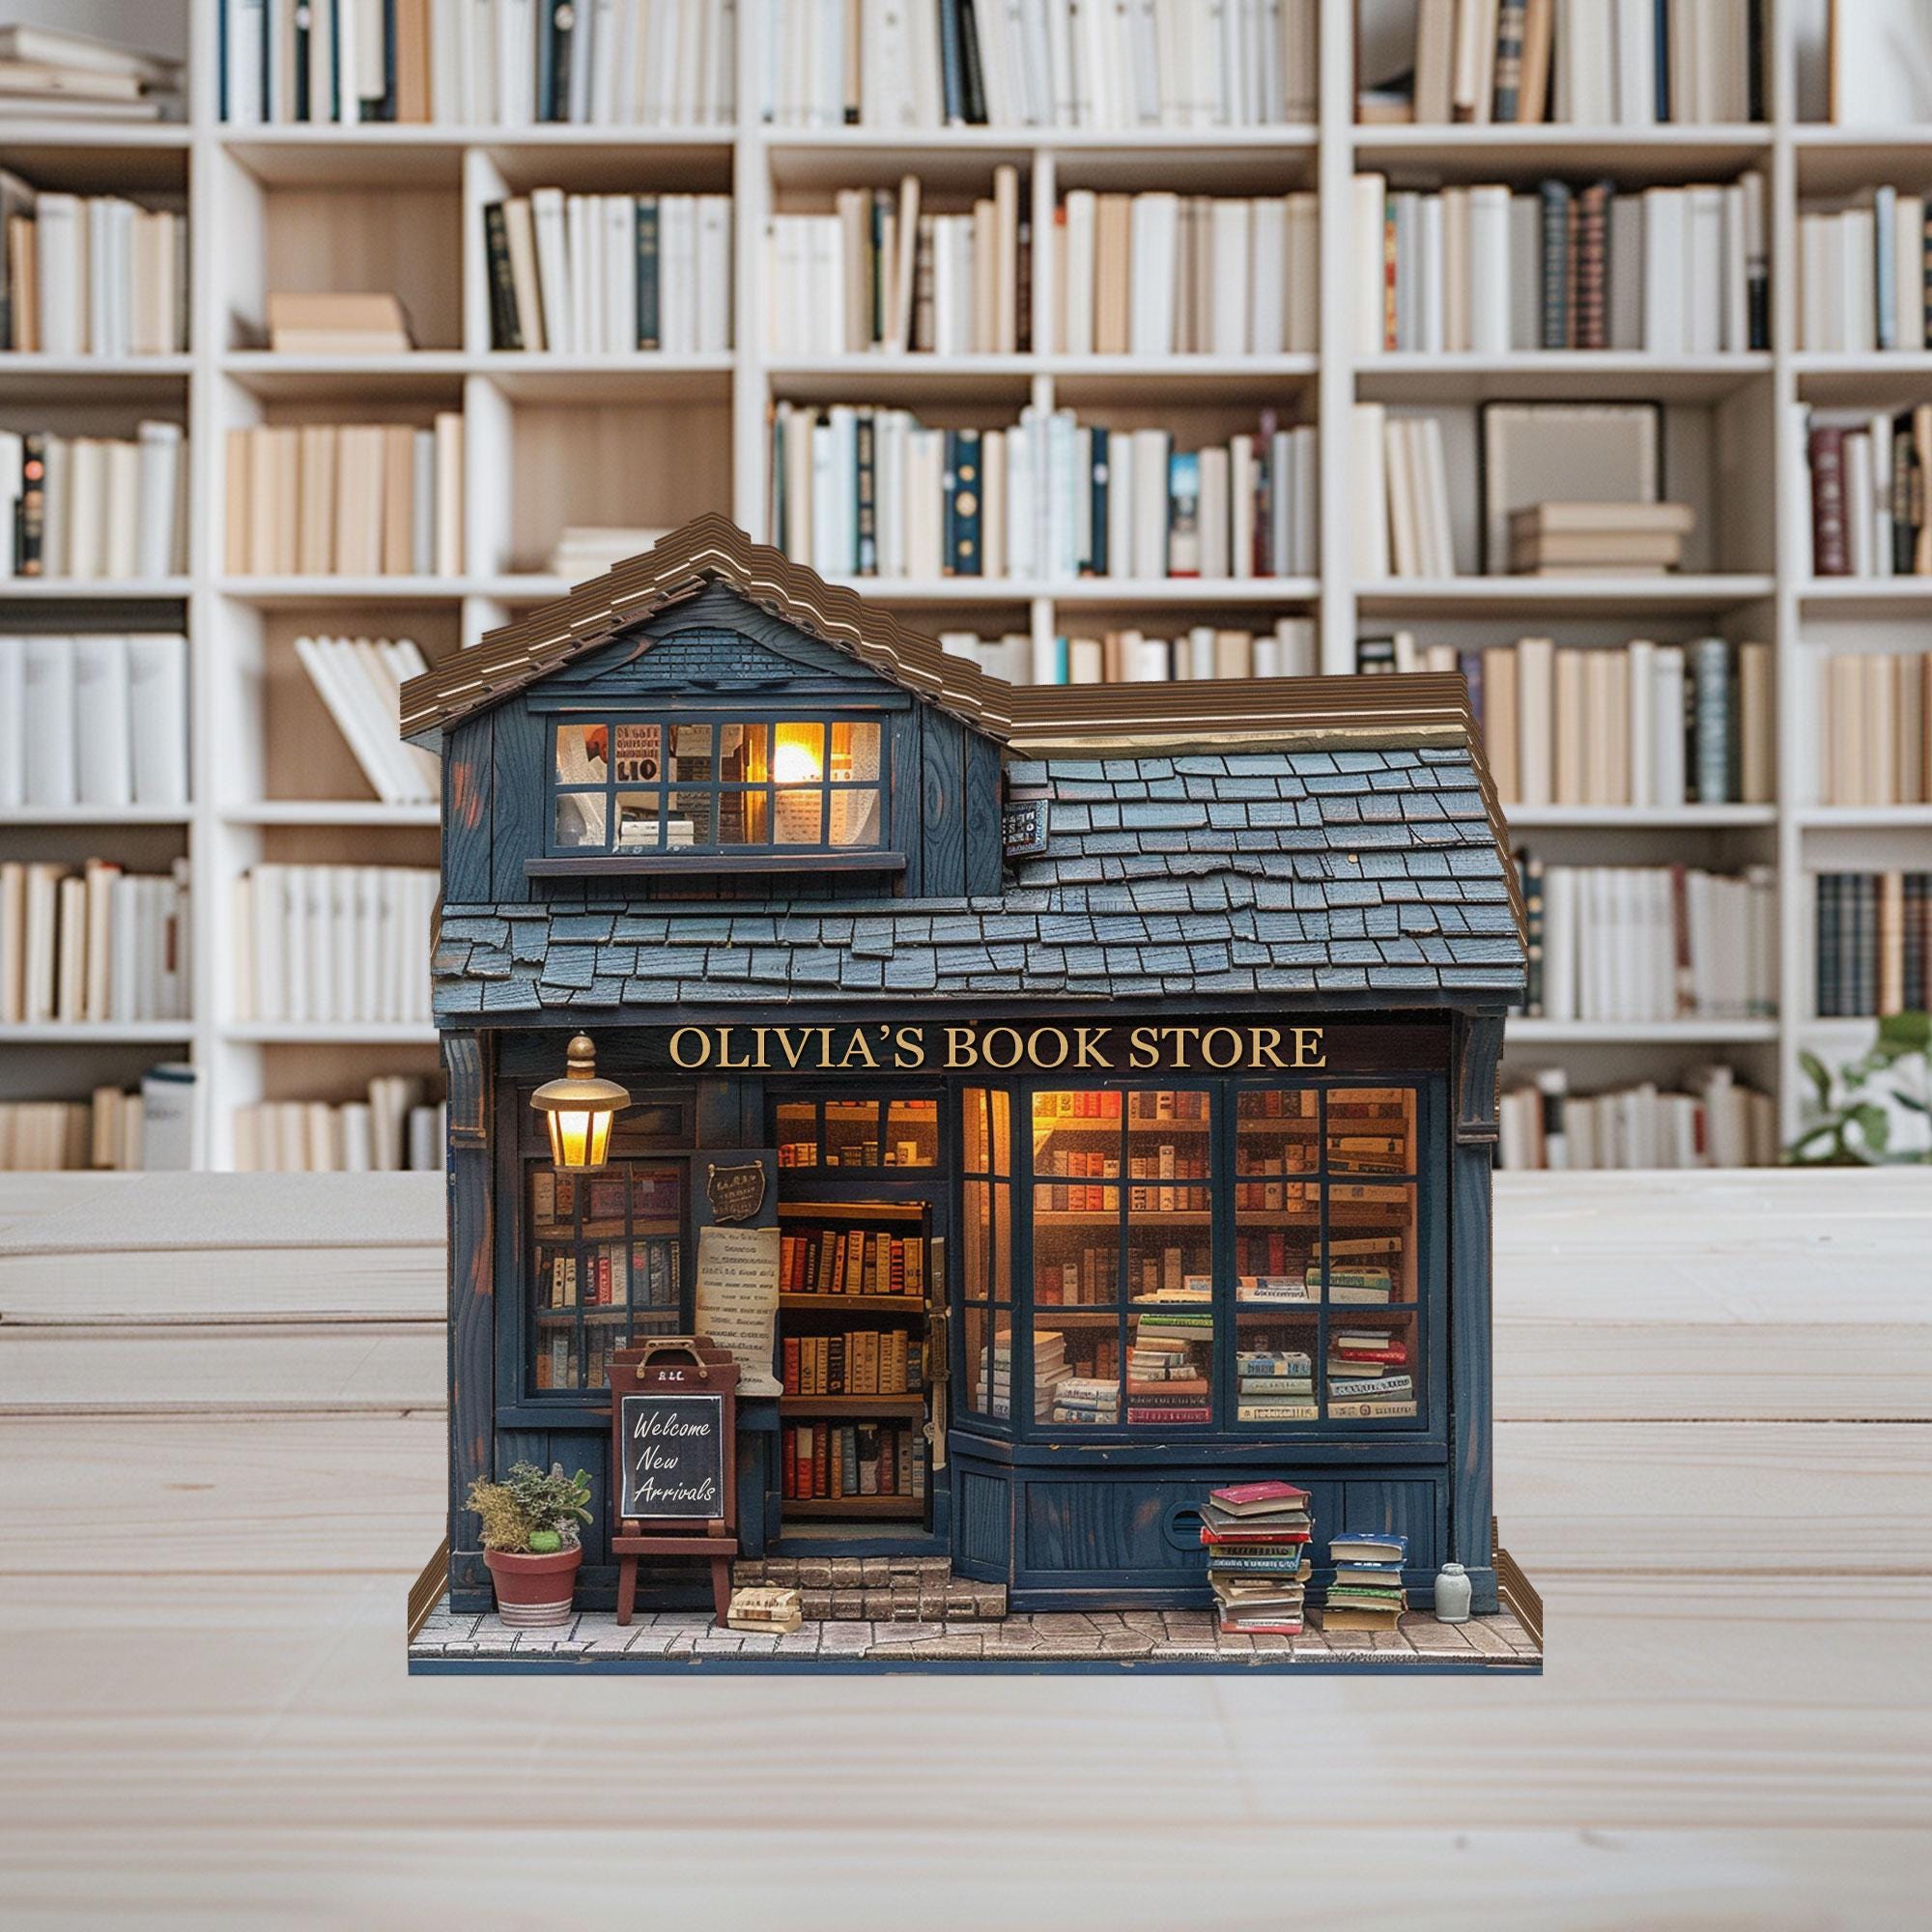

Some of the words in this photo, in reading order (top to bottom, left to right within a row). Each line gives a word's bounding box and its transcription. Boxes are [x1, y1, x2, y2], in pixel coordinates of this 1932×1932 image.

[668, 1026, 924, 1068] OLIVIA'S
[943, 1027, 1112, 1068] BOOK
[1129, 1026, 1327, 1068] STORE
[634, 1410, 711, 1439] Welcome
[636, 1444, 679, 1471] New
[634, 1476, 716, 1503] Arrivals
